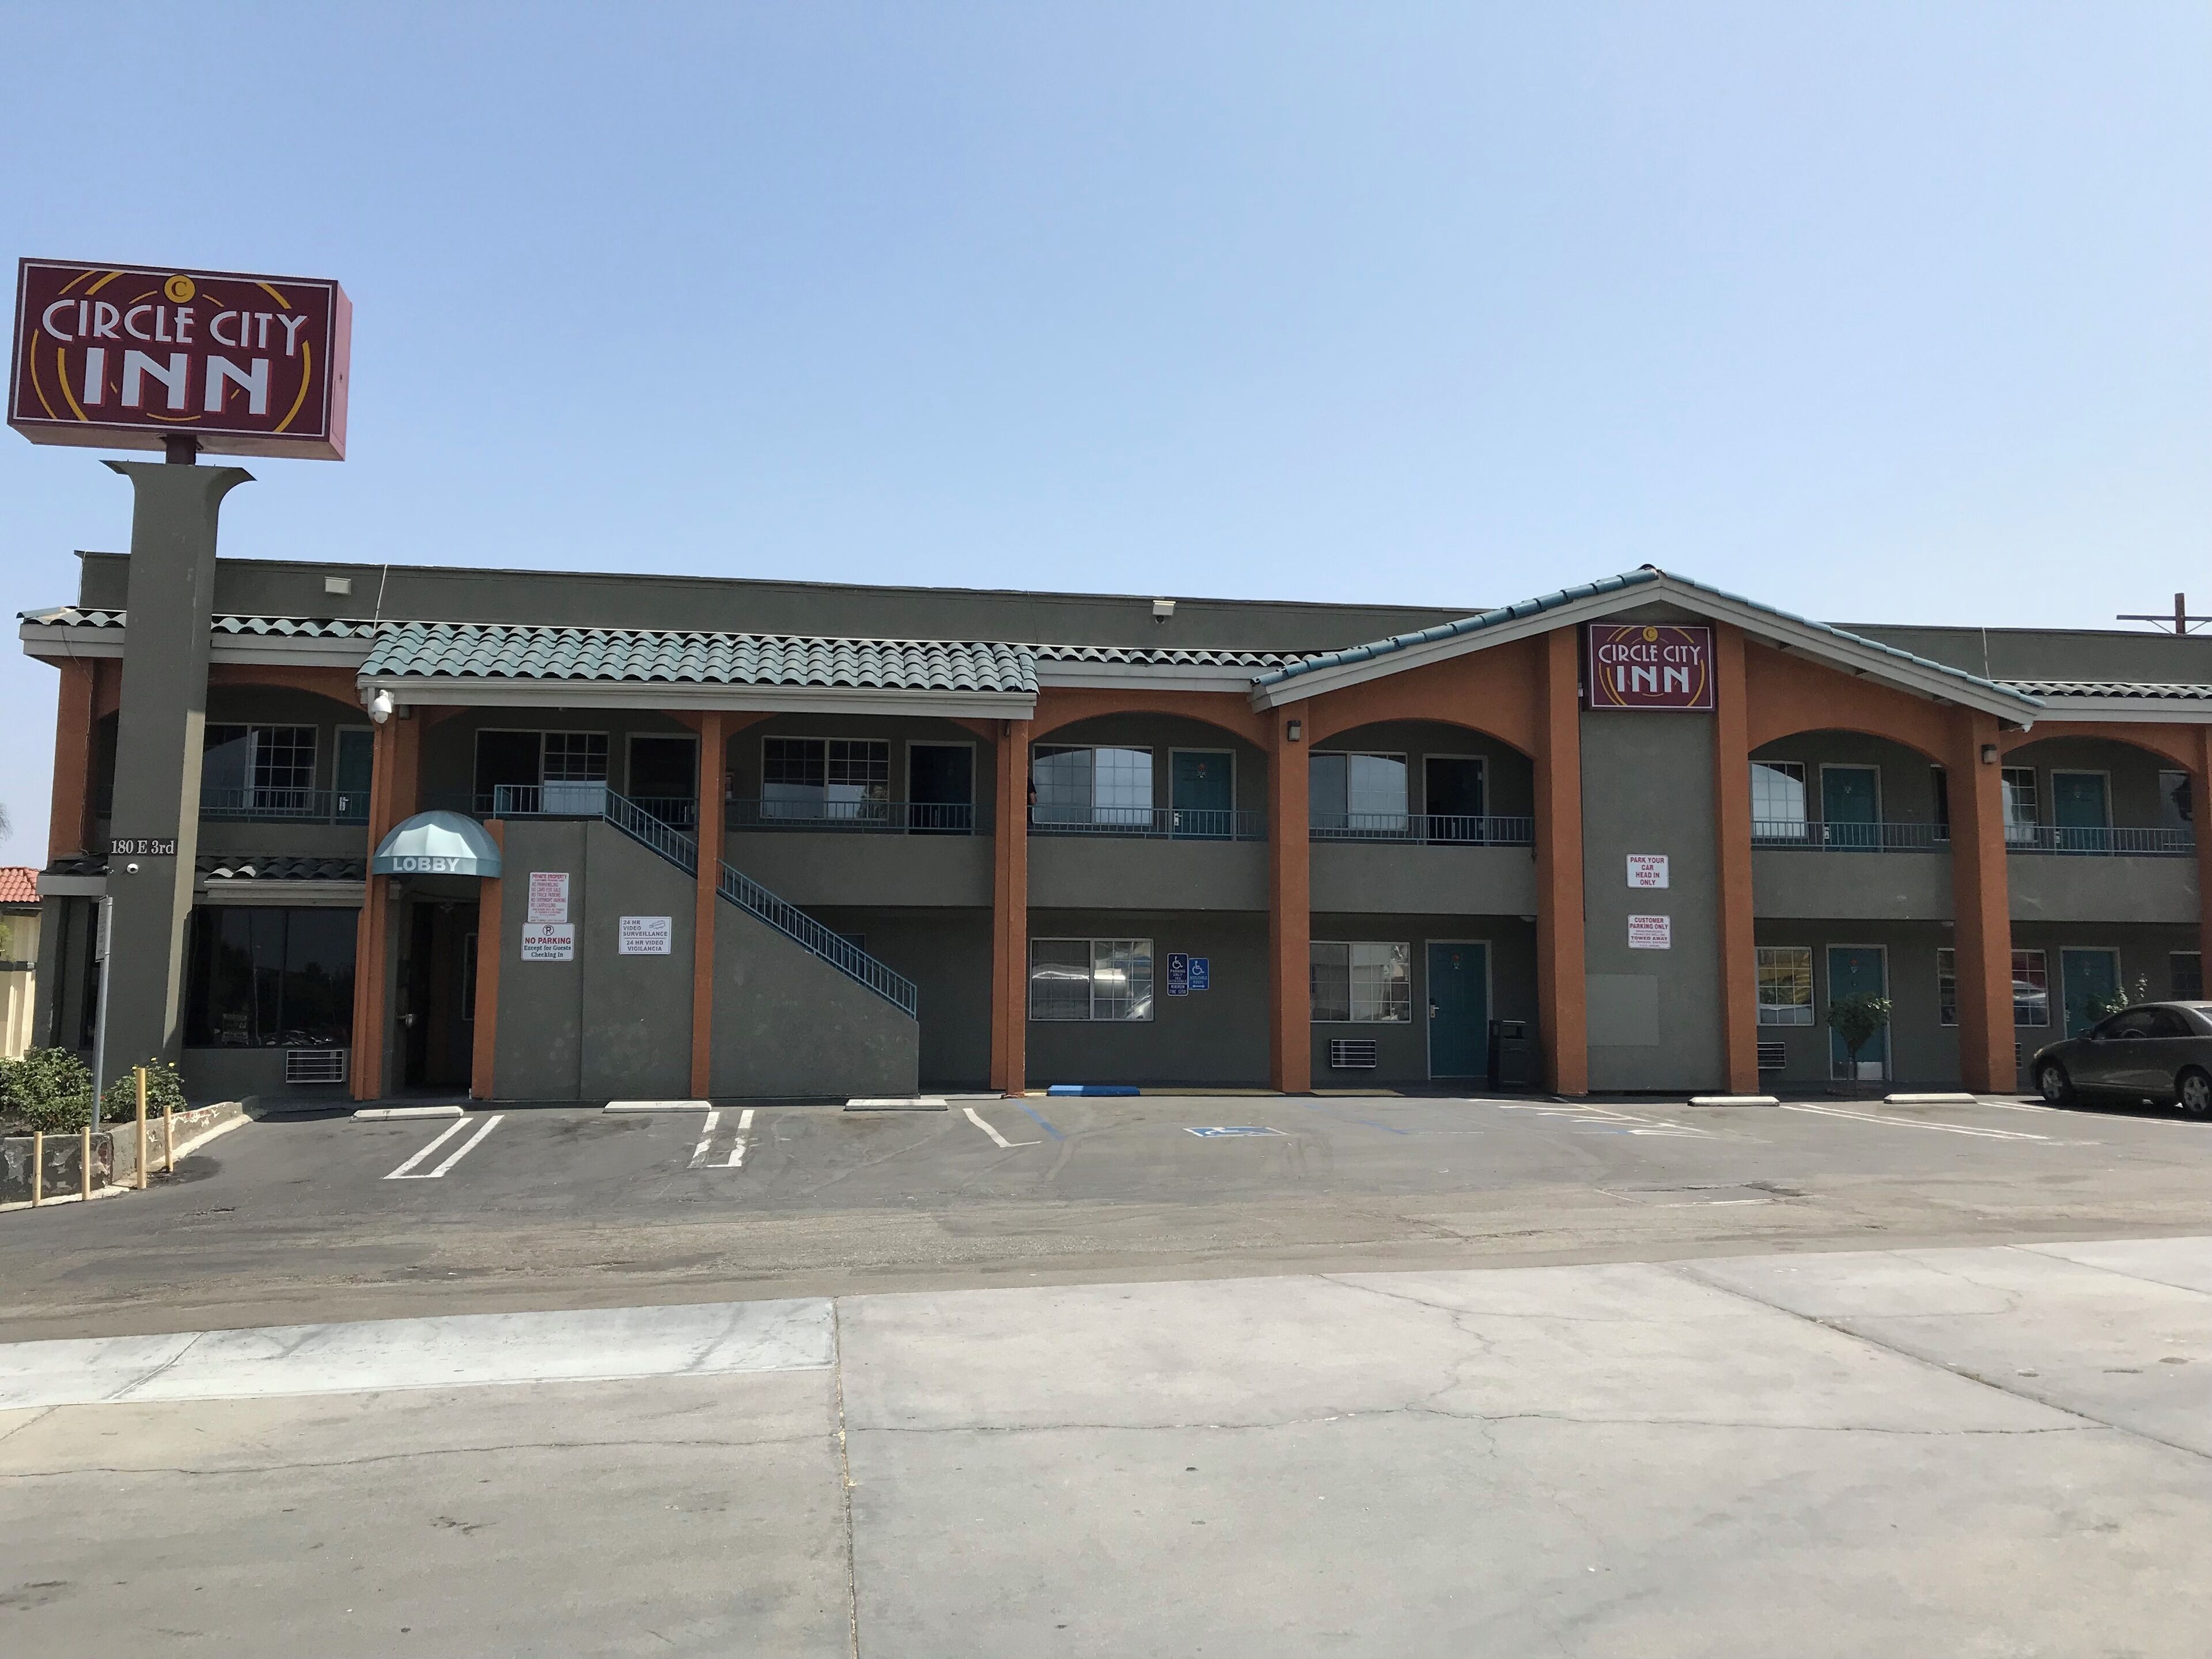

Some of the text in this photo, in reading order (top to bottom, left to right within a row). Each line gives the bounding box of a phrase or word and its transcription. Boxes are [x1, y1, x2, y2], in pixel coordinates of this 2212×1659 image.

[172, 281, 187, 297] C
[43, 300, 309, 357] CIRCLE CITY
[83, 347, 271, 415] INN
[1598, 644, 1701, 665] CIRCLE CITY
[1616, 665, 1690, 693] INN
[111, 839, 175, 854] 180 E 3rd
[393, 857, 460, 872] LOBBY
